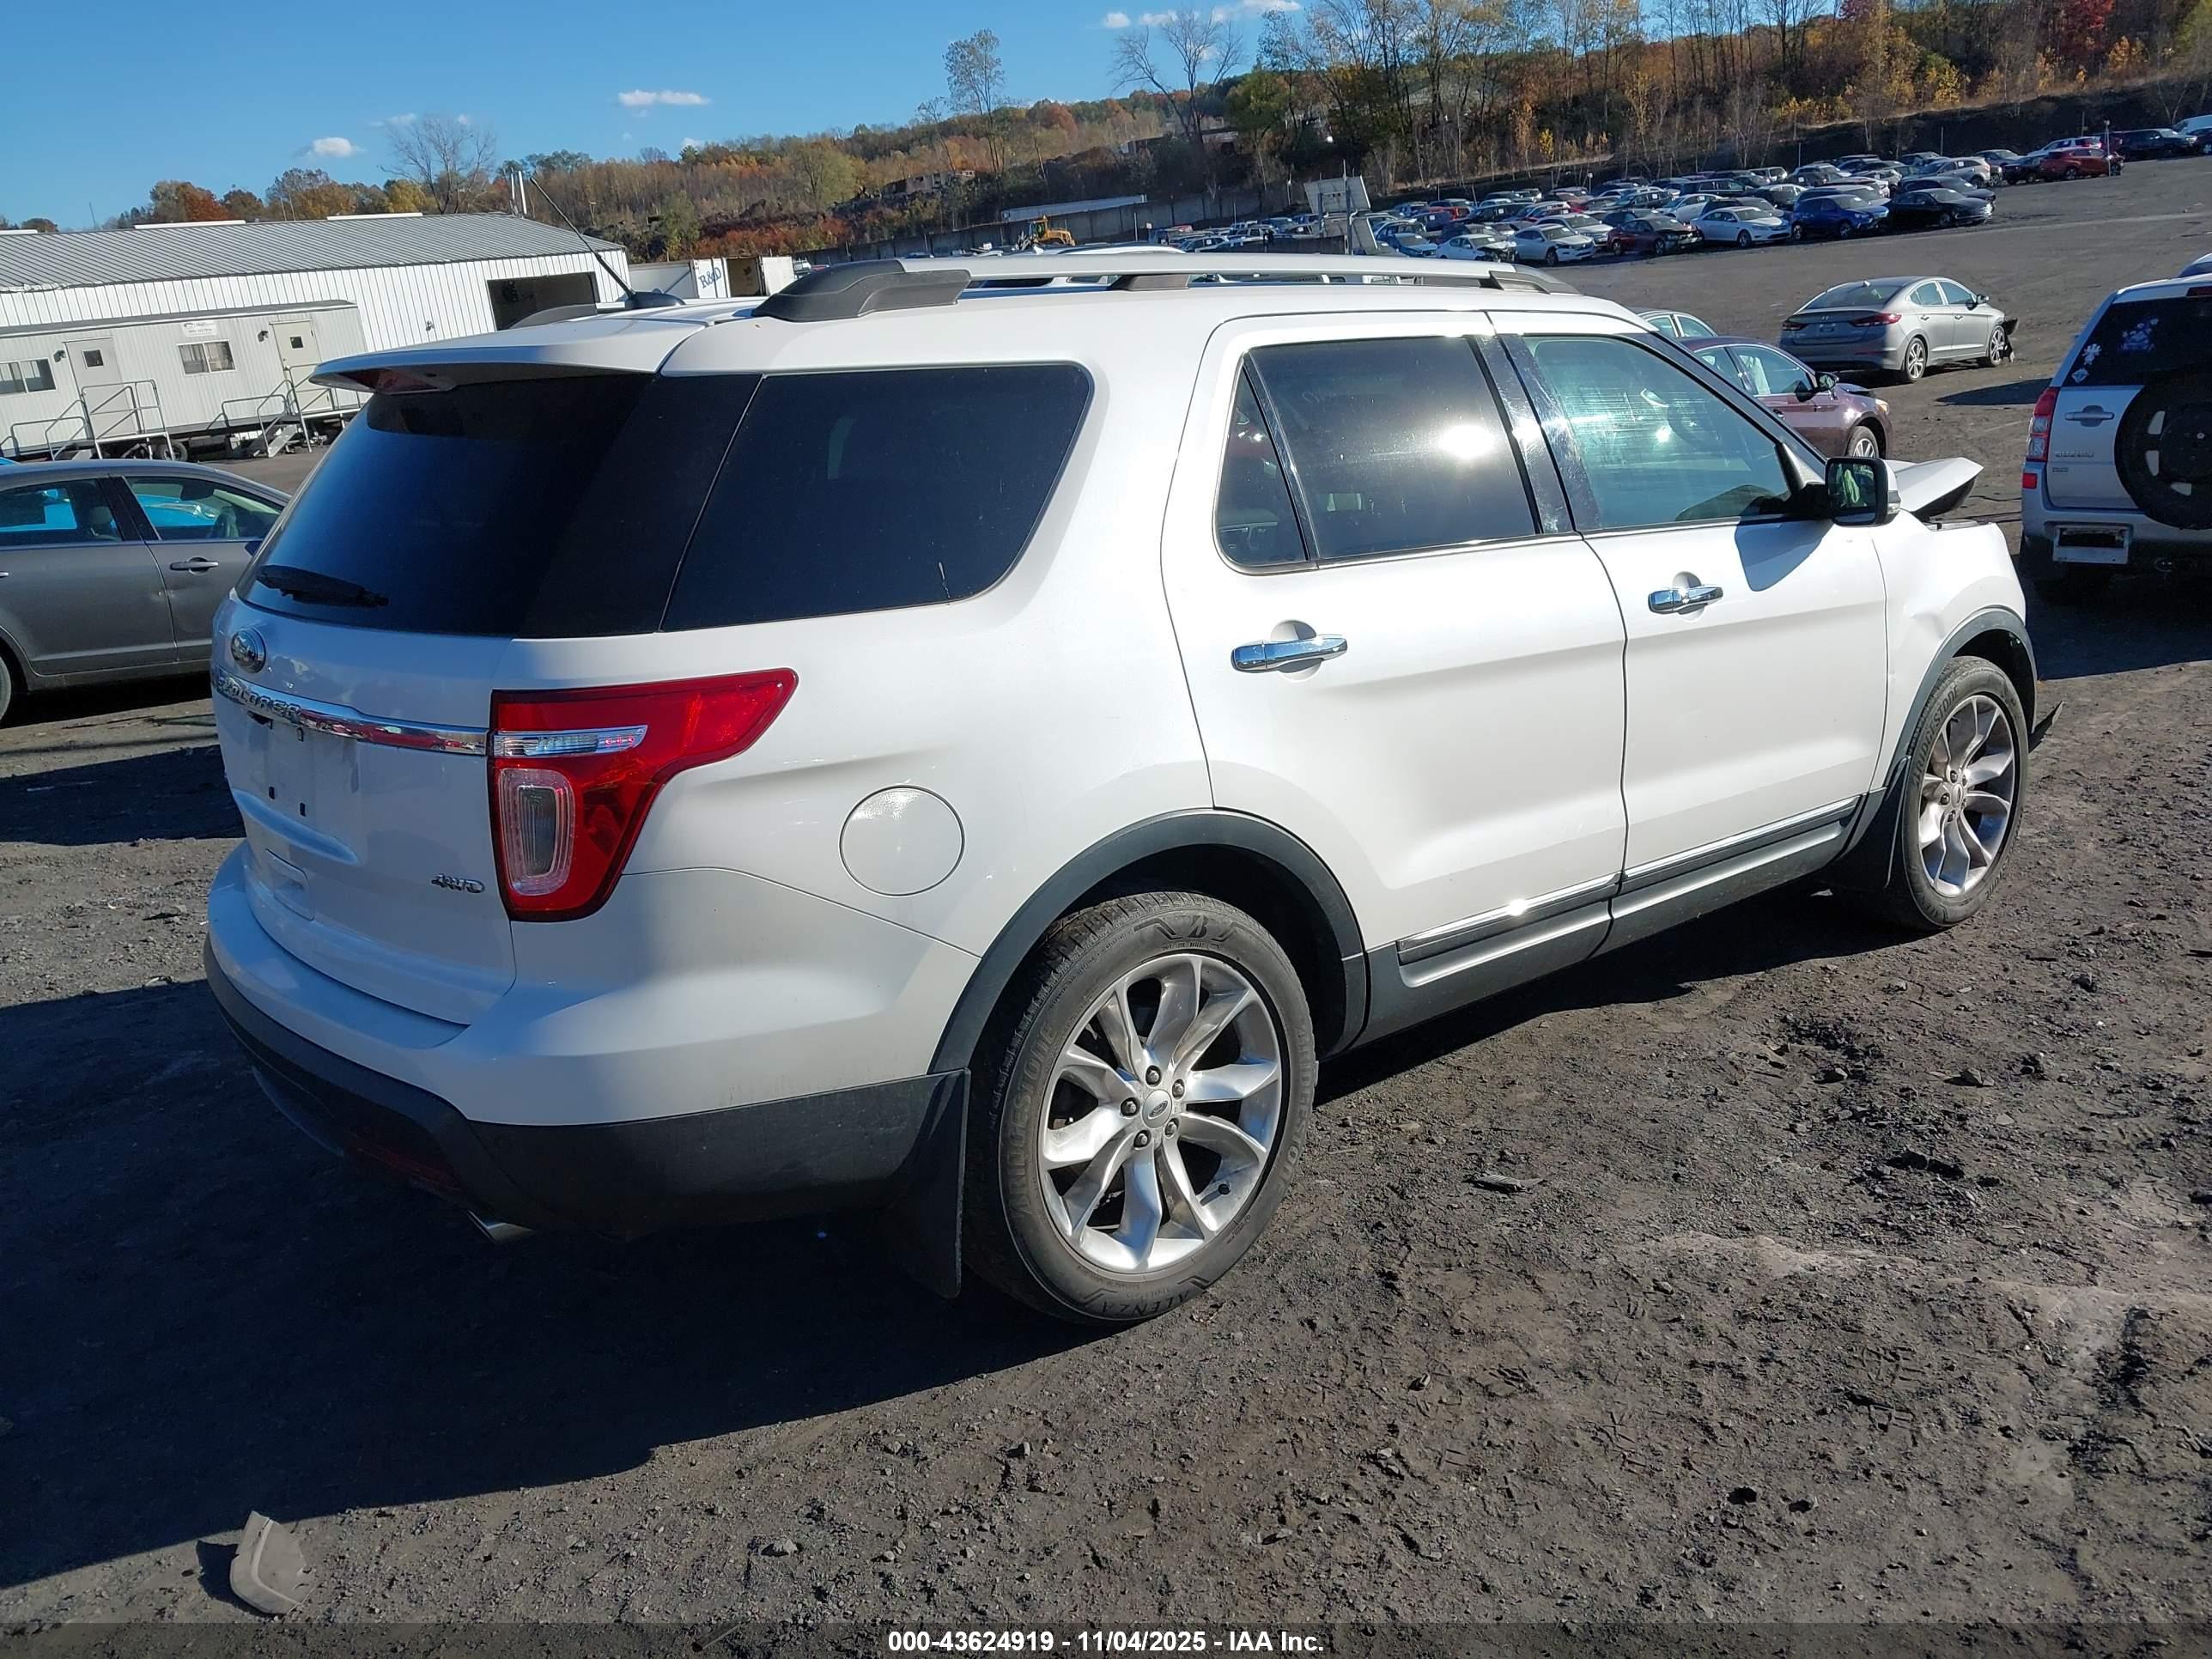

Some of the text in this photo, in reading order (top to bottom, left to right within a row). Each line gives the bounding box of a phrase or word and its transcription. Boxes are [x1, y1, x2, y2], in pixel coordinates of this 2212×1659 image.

[698, 267, 722, 289] R&D
[431, 872, 486, 894] 4WD
[1008, 1022, 1059, 1216] BRIDGESTONE
